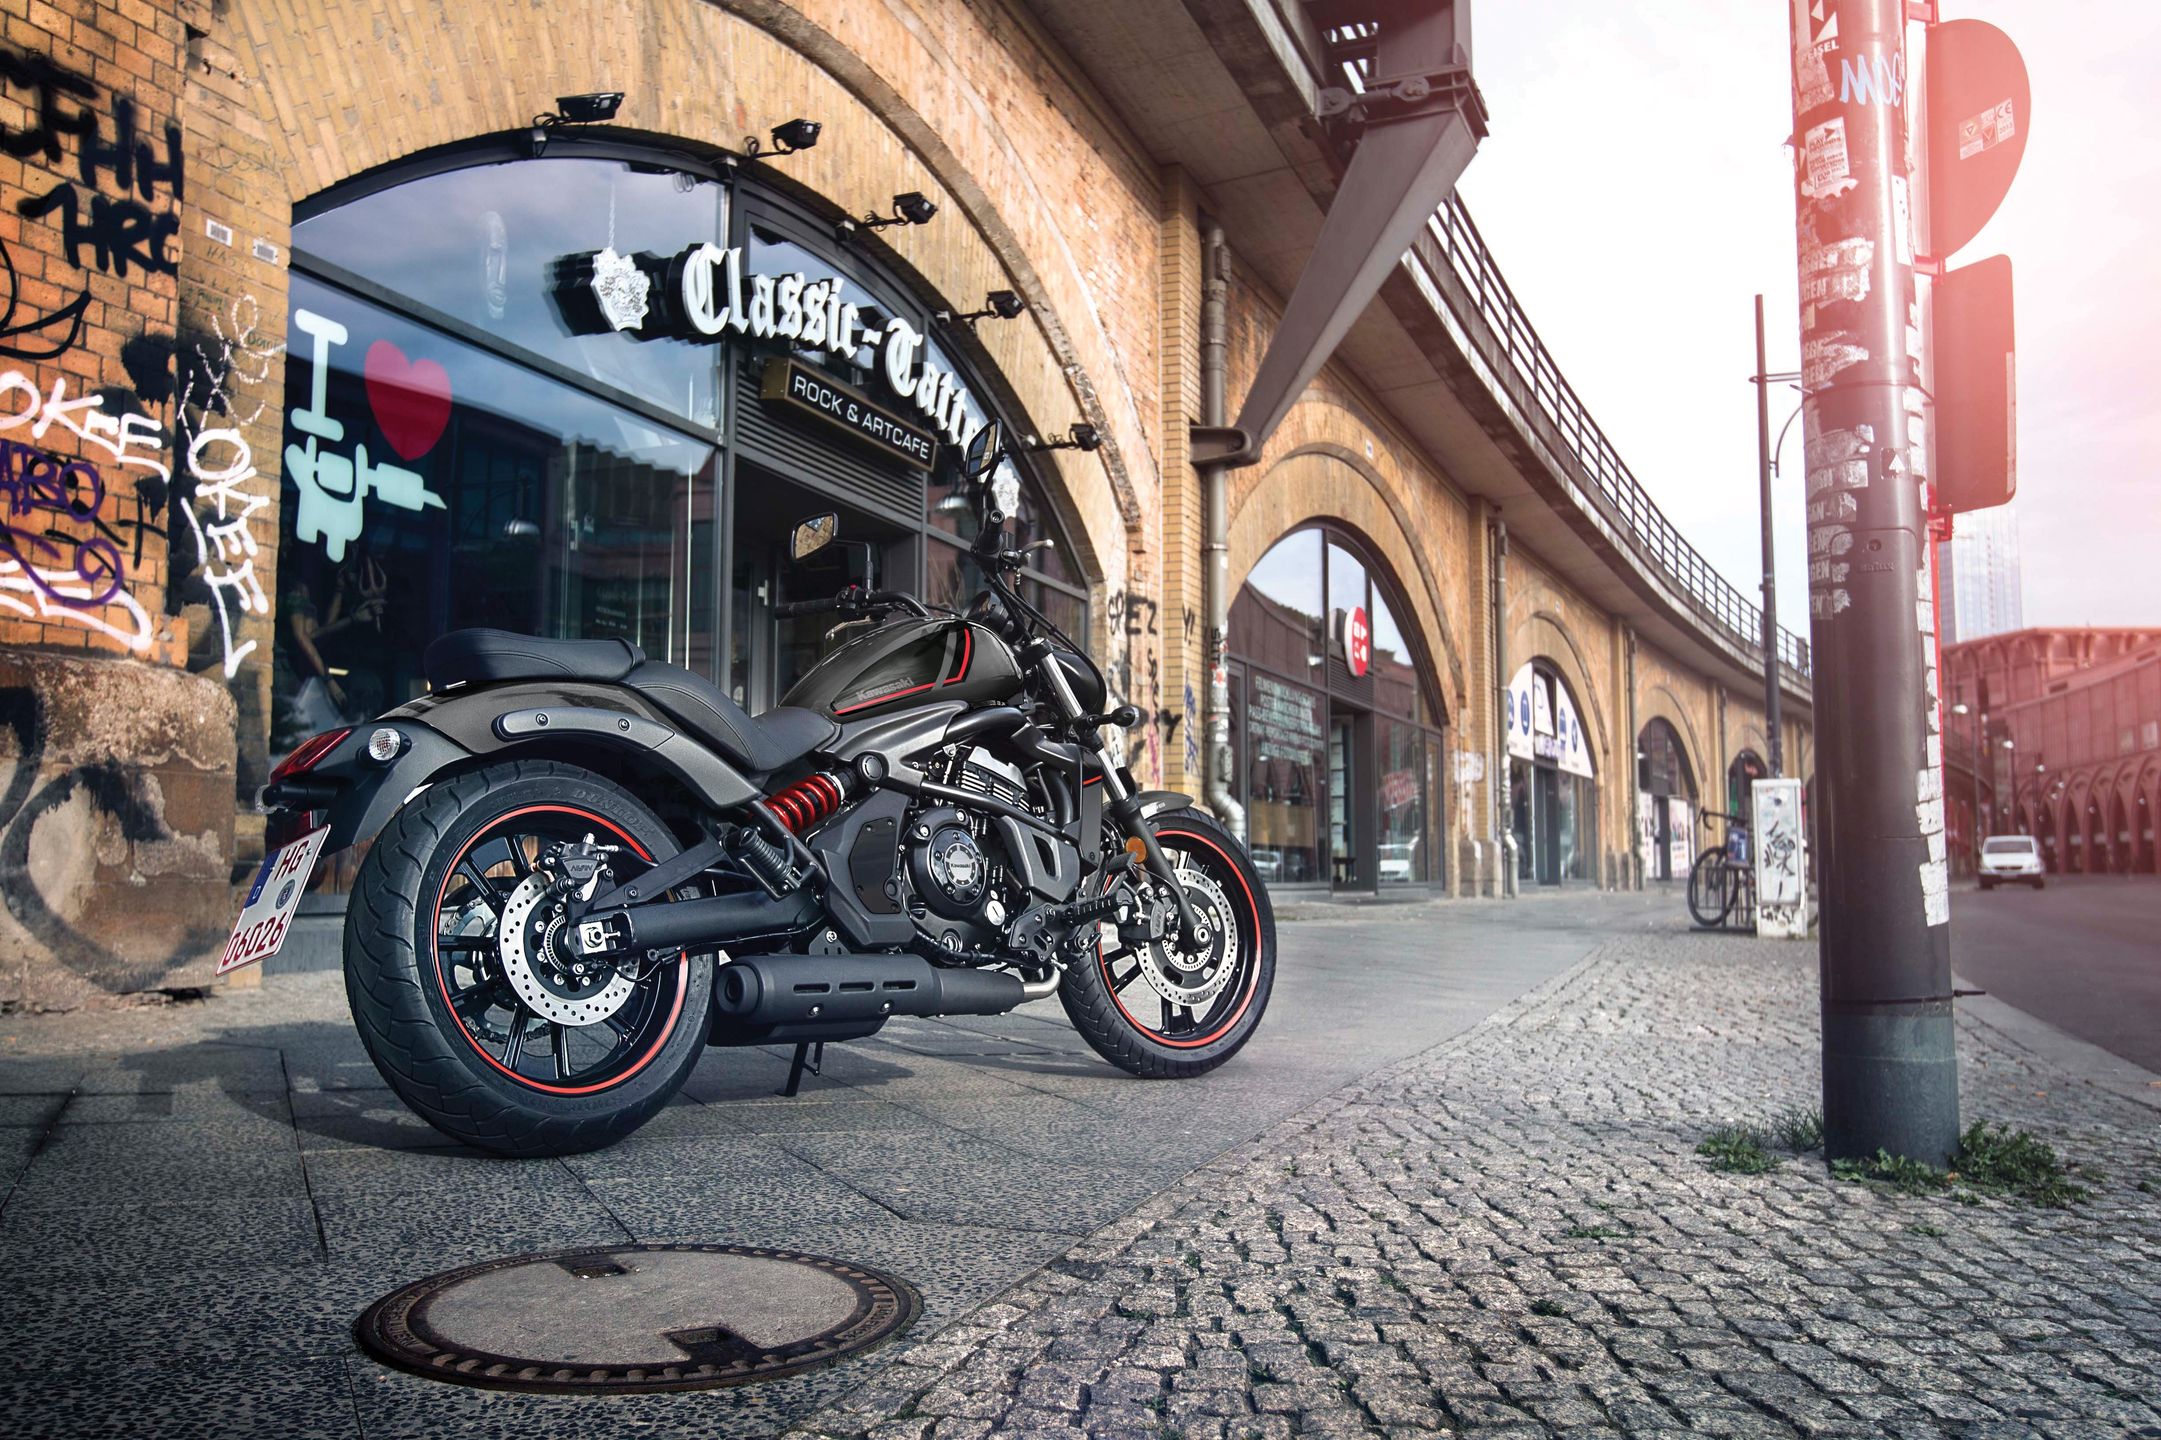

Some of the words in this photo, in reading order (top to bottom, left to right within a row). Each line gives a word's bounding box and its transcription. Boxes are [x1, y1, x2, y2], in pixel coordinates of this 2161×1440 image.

[793, 374, 843, 416] ROCK
[846, 403, 859, 423] &
[862, 411, 931, 461] ARTCAFE
[856, 677, 915, 701] Kawasaki
[274, 840, 310, 881] HG
[222, 911, 287, 966] 06026
